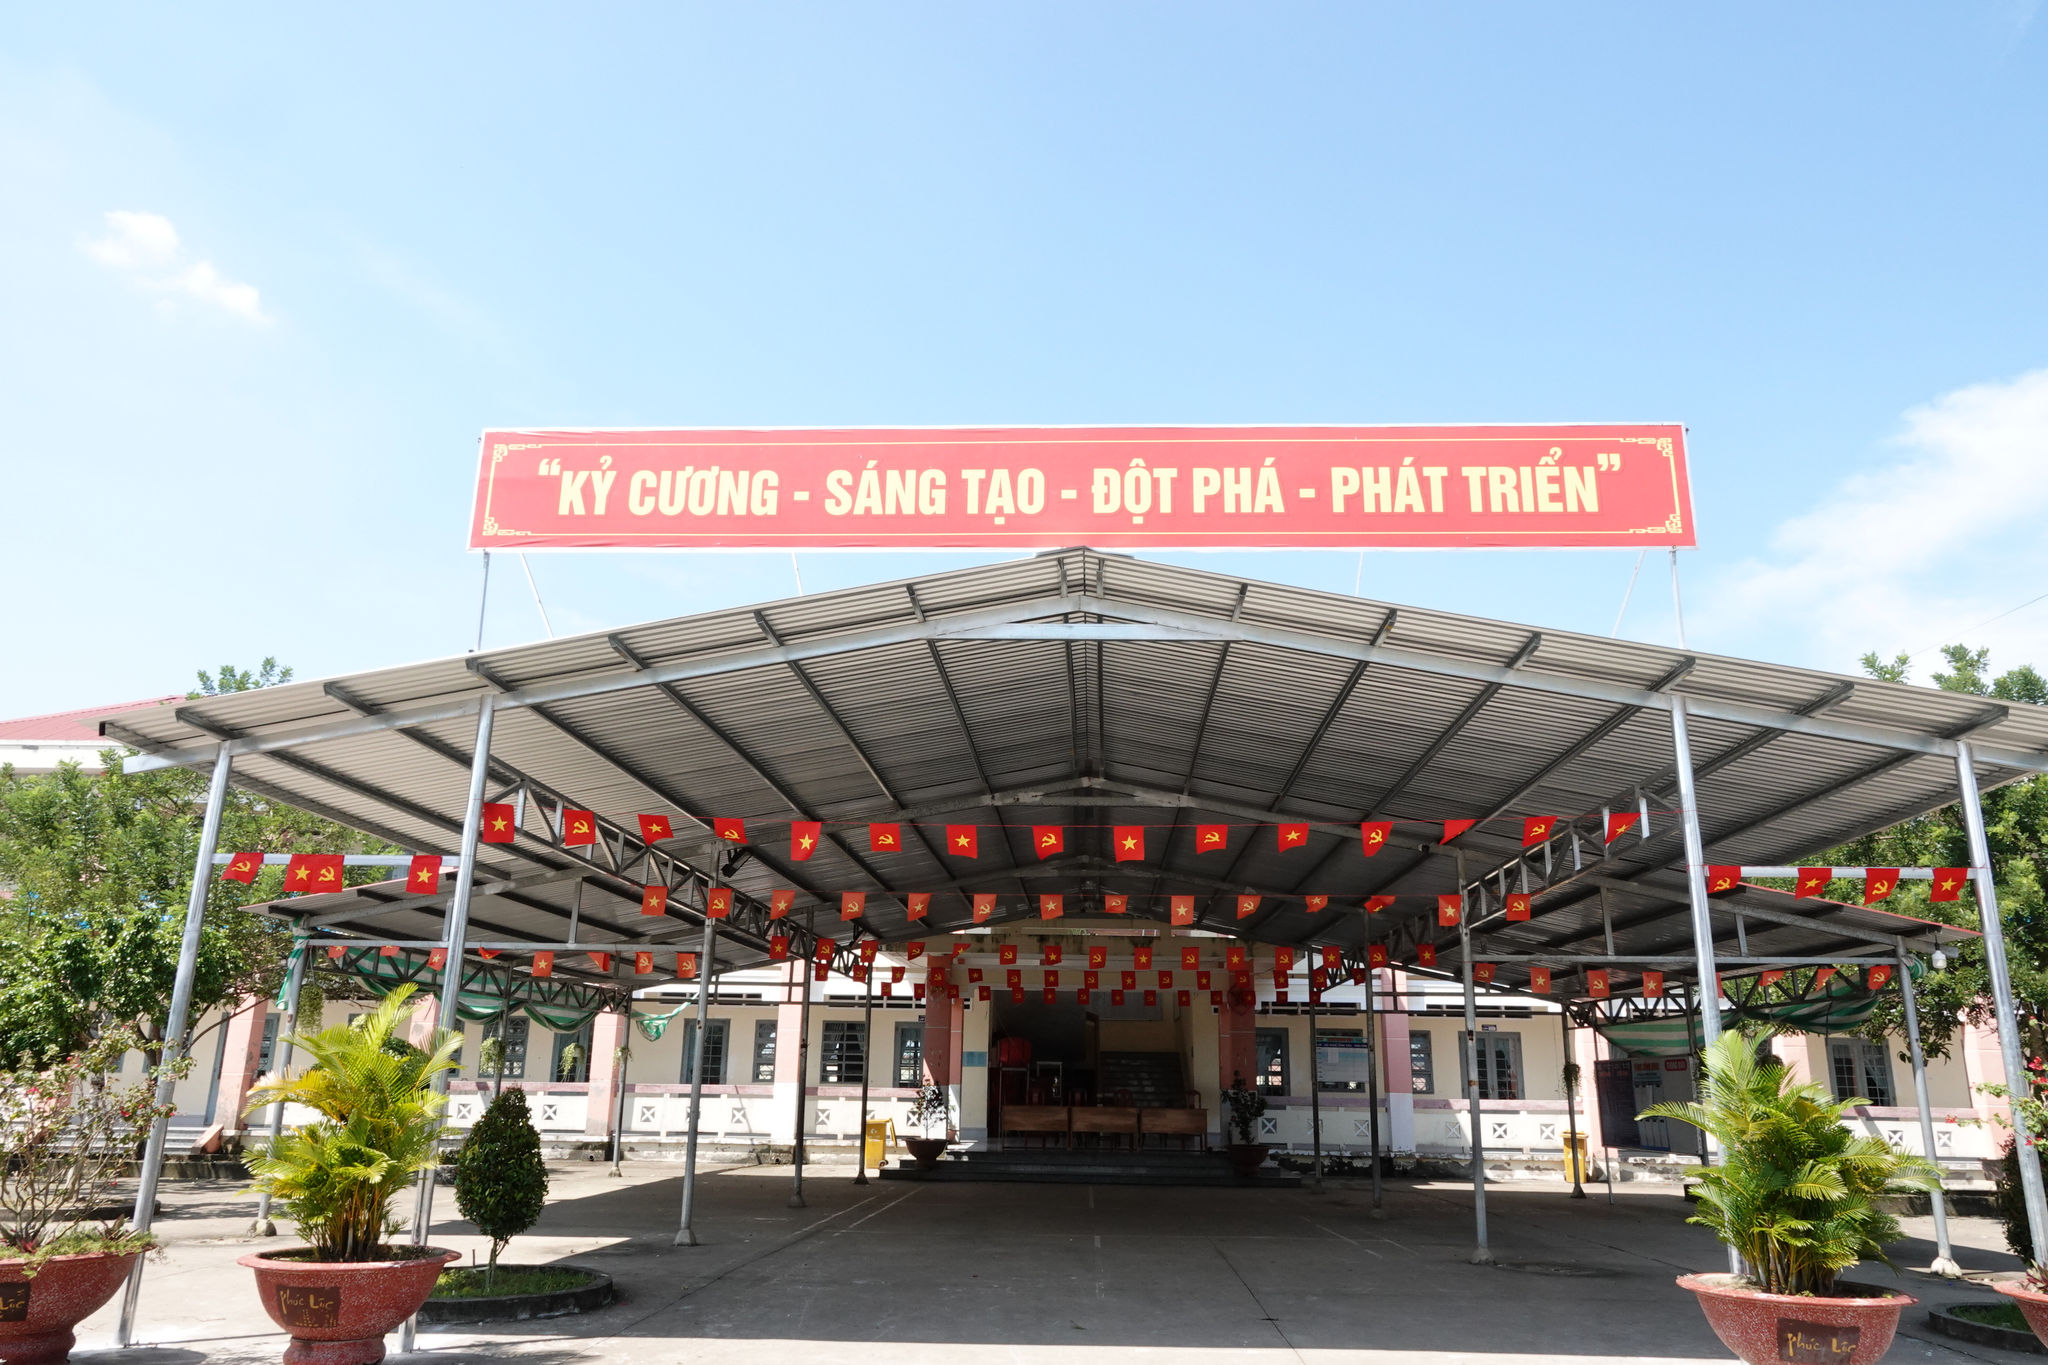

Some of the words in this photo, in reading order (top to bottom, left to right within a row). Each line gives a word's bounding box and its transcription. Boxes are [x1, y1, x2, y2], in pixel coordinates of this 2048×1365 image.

[538, 455, 616, 515] “KỶ
[629, 466, 779, 516] CƯƠNG
[793, 490, 810, 501] -
[825, 460, 946, 515] SÁNG
[961, 468, 1045, 525] TẠO
[1060, 489, 1078, 500] -
[1092, 458, 1178, 525] ĐỘT
[1193, 457, 1284, 513] PHÁ
[1299, 488, 1316, 499] -
[1331, 457, 1448, 513] PHÁT
[1462, 447, 1620, 513] TRIỂN”
